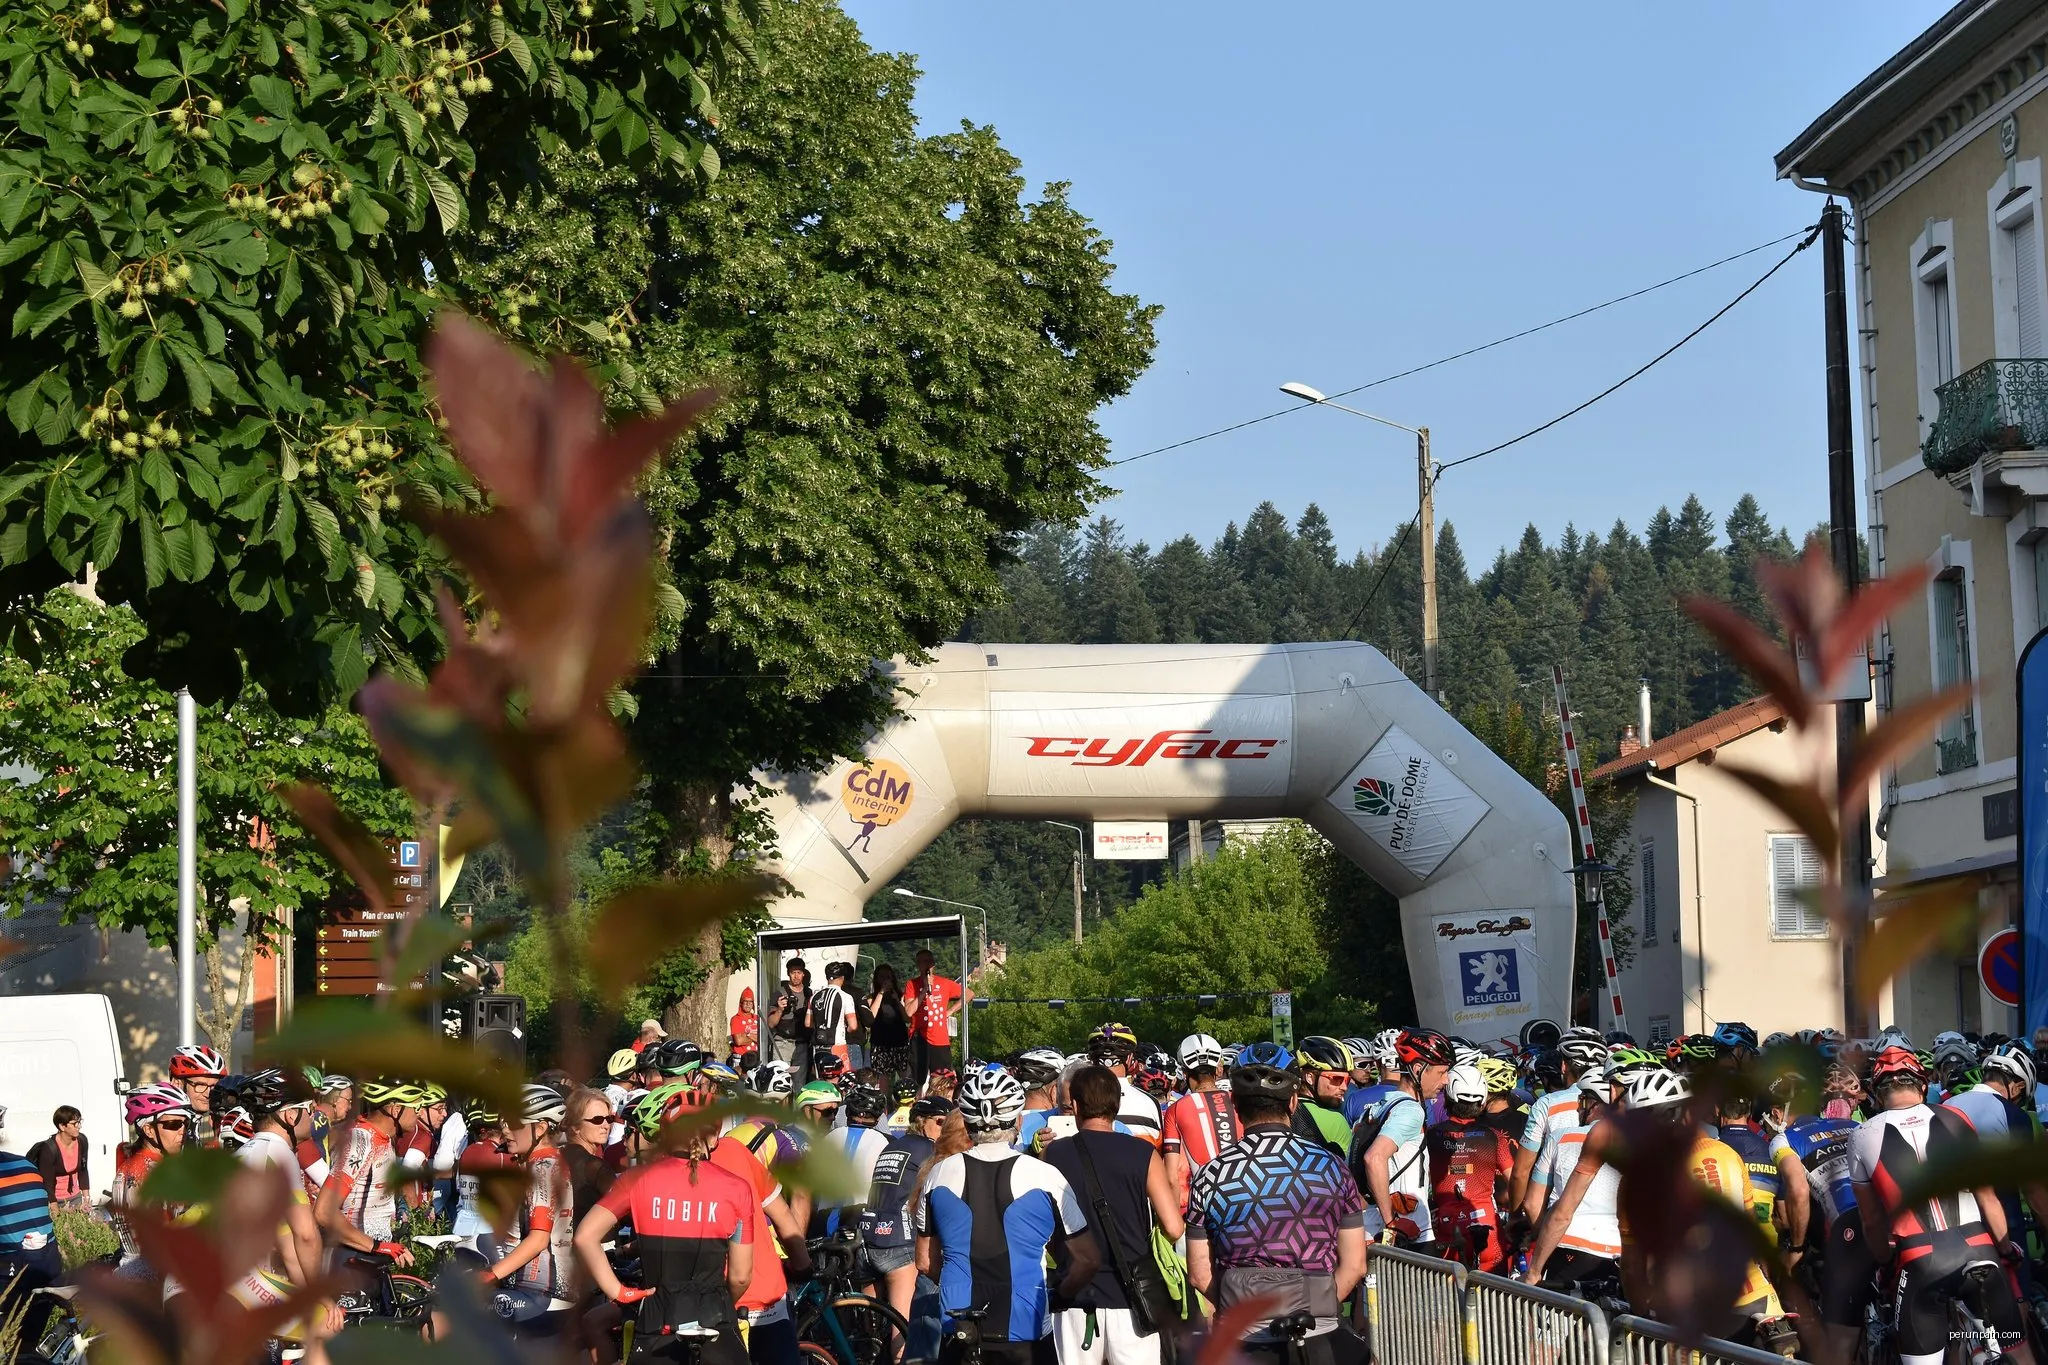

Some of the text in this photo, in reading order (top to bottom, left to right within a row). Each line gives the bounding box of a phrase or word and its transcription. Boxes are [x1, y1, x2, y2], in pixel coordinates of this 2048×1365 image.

[1009, 729, 1278, 767] cyfac
[847, 769, 911, 805] CdM
[852, 794, 899, 815] interim
[1402, 811, 1419, 853] CONSEIL
[362, 910, 377, 920] Plan
[377, 910, 395, 920] d'eau
[342, 928, 383, 938] Train Tourist
[1466, 991, 1519, 1004] PEUGEOT
[1745, 1162, 1777, 1175] IGNAIS
[652, 1196, 718, 1223] GOBIK
[245, 1276, 283, 1305] INTERS
